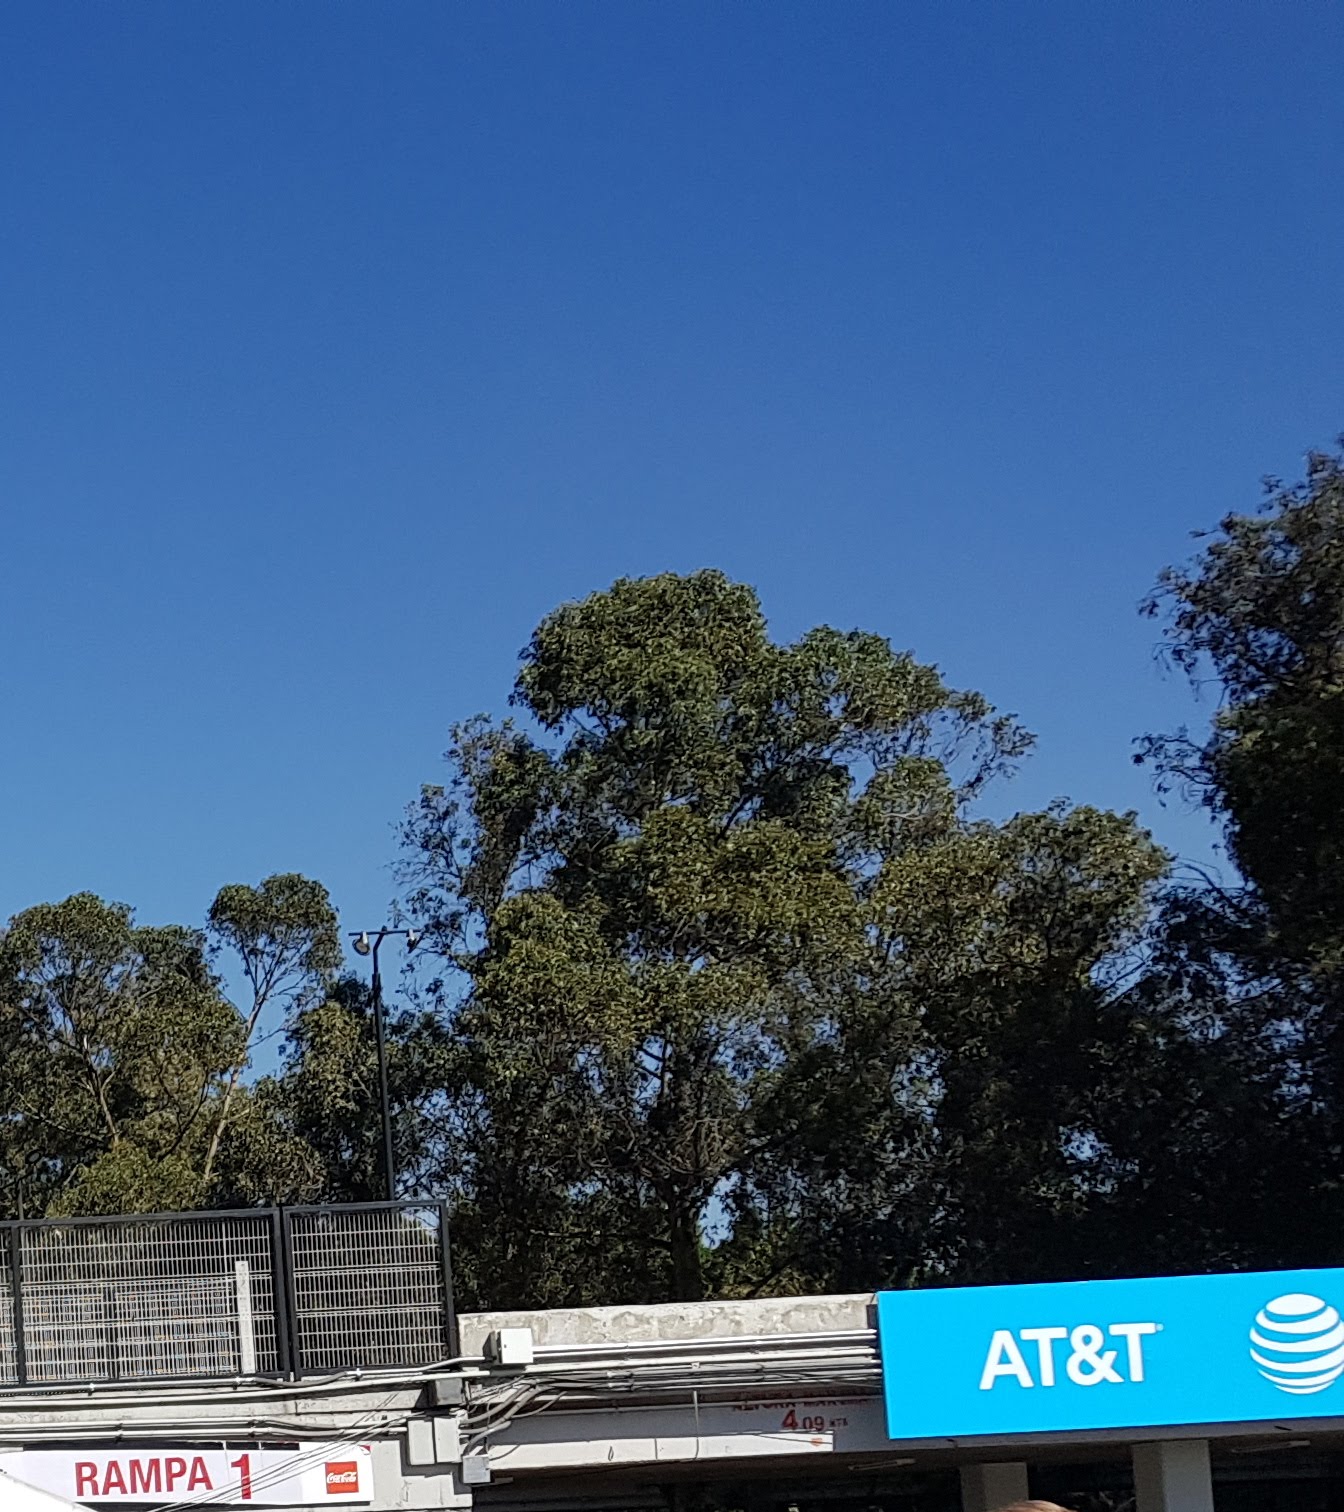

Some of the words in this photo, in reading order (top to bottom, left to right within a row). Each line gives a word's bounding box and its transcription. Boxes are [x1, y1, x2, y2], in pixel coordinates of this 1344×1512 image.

[979, 1323, 1162, 1390] AT&T
[75, 1456, 213, 1496] RAMPA
[231, 1453, 252, 1500] 1
